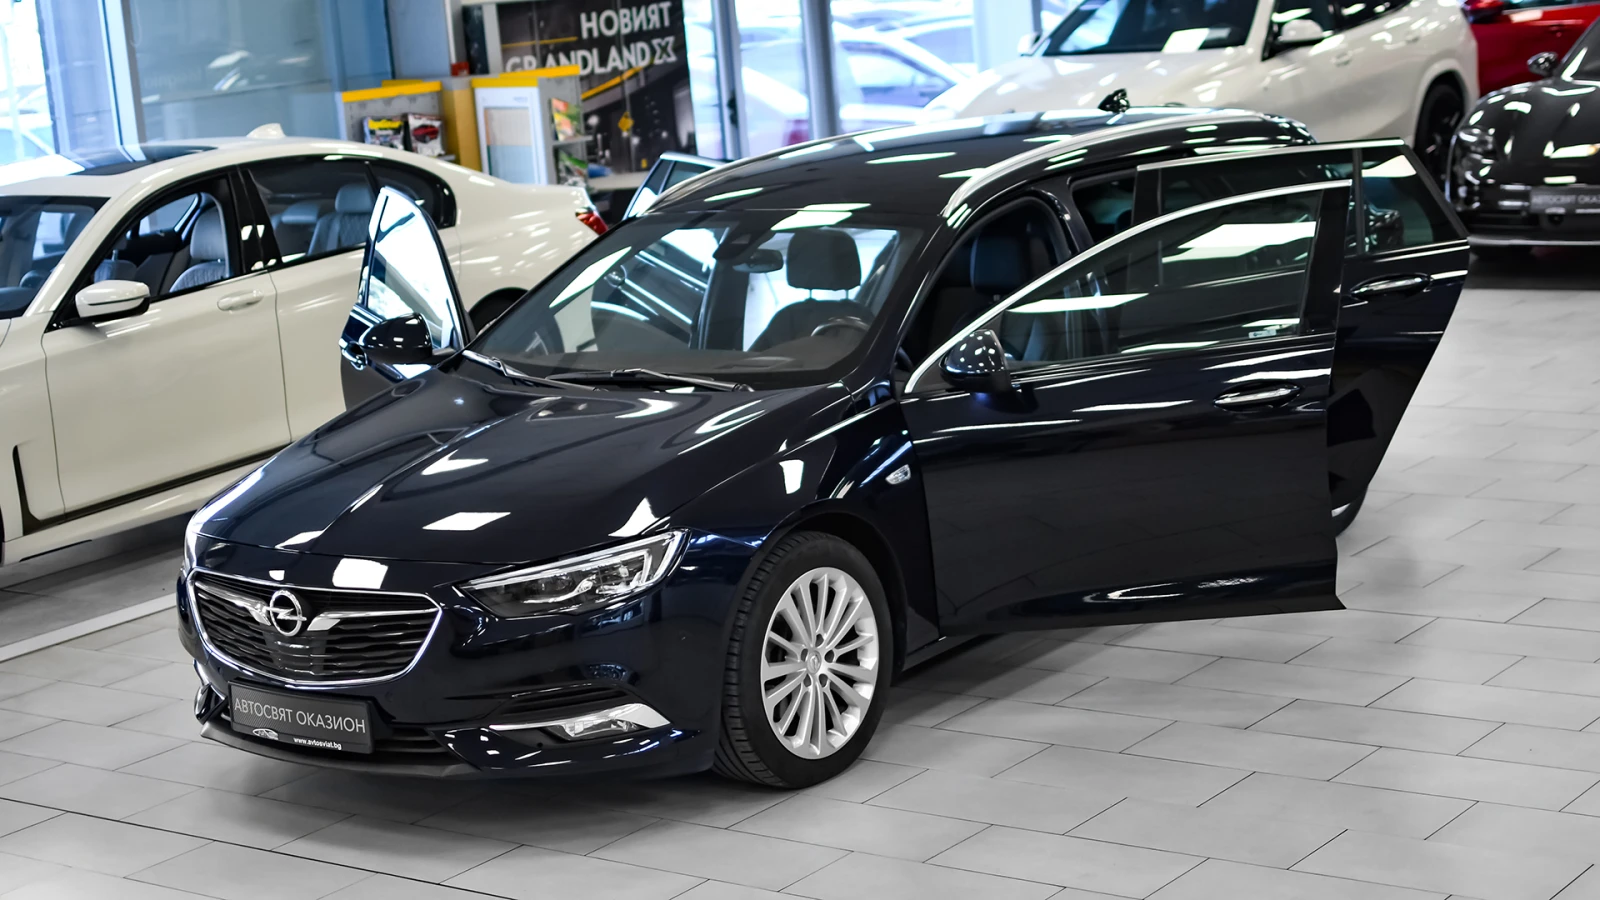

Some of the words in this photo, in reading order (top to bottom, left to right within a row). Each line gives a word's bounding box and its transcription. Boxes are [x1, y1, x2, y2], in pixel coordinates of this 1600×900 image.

[580, 1, 672, 39] НОВИЯТ
[234, 698, 293, 723] АВТОСВЯТ
[296, 710, 366, 733] ОКАЗИОН
[293, 737, 342, 750] www.avtosviat.bg
